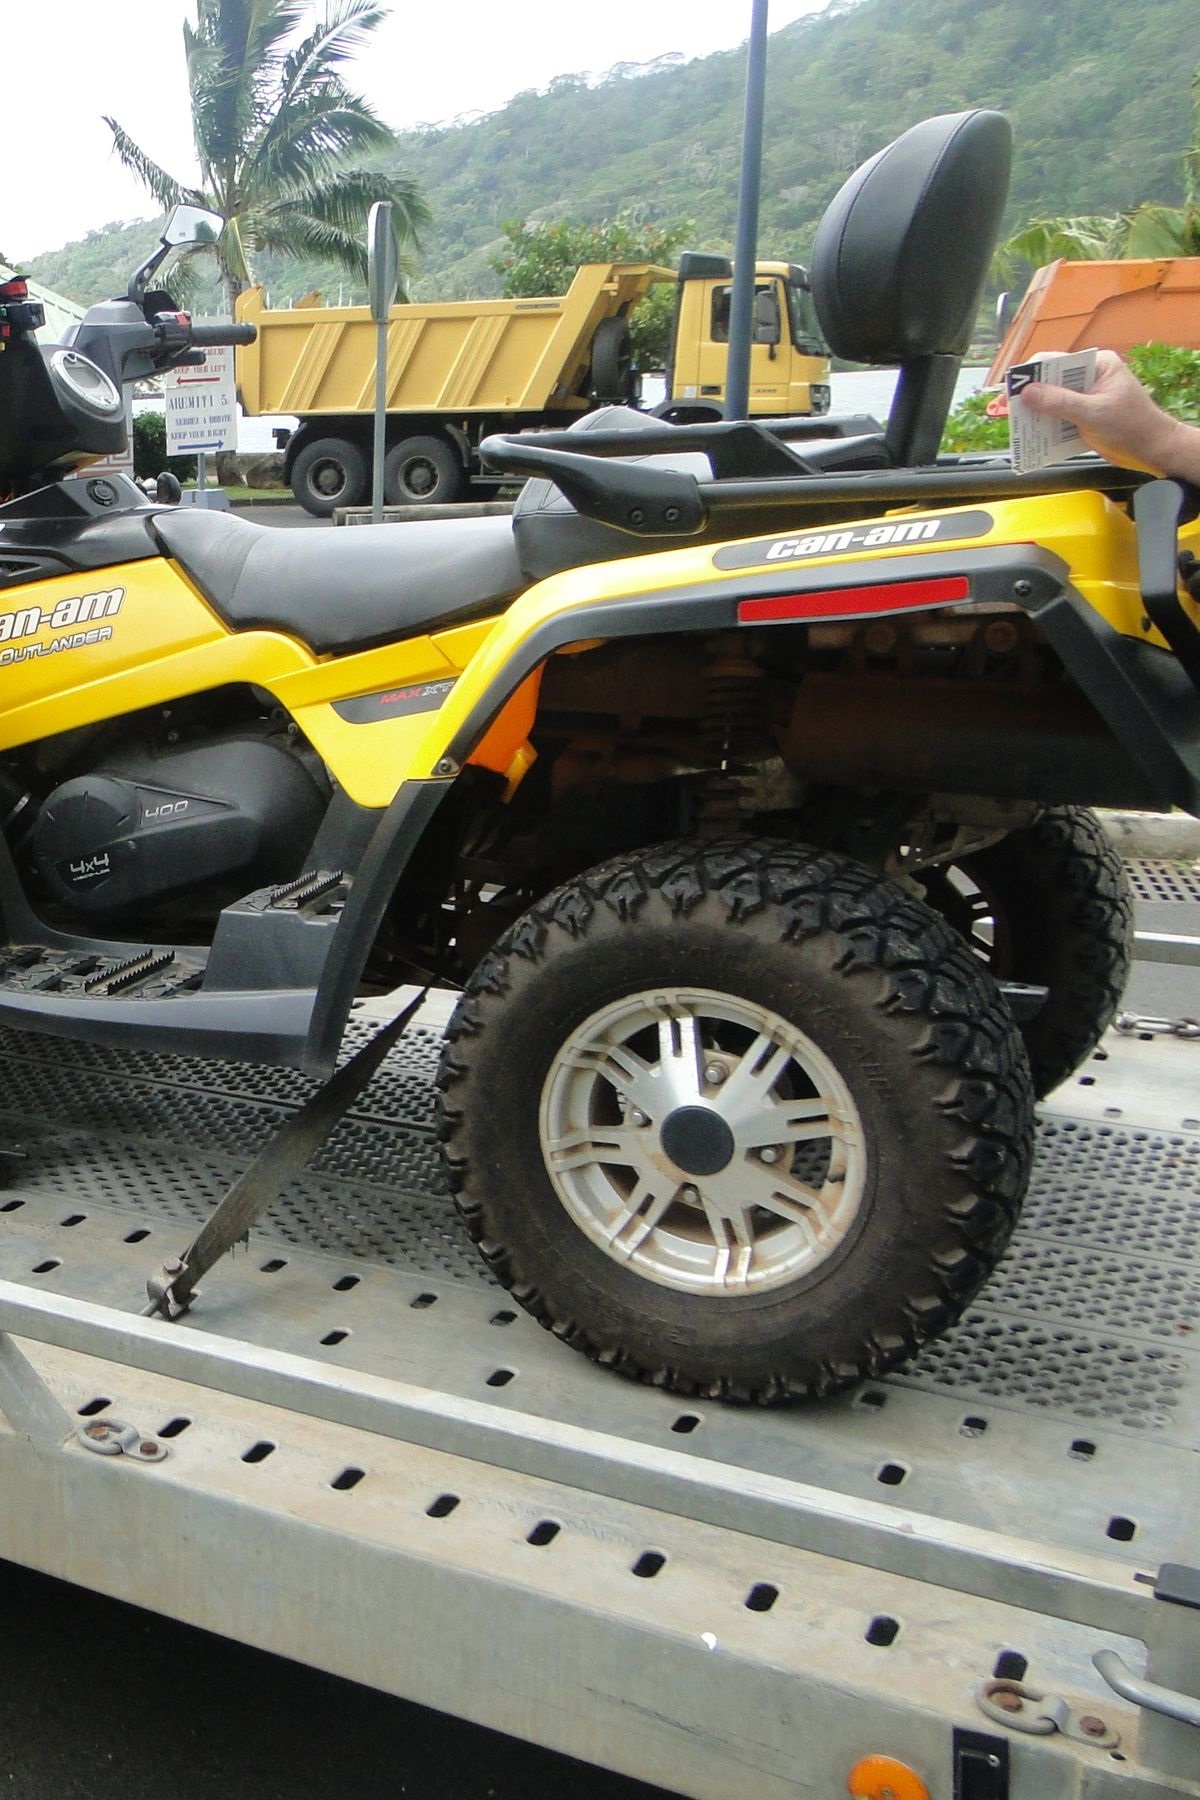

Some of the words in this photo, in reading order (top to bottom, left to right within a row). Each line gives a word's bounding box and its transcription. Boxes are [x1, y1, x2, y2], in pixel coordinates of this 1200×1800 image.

[174, 367, 190, 375] KEEP
[210, 364, 227, 373] LEFT
[1011, 374, 1031, 390] V
[168, 395, 214, 411] AREMITI
[220, 393, 228, 406] 5
[170, 431, 188, 440] KEEP
[765, 519, 941, 560] can-am
[145, 800, 189, 818] 400
